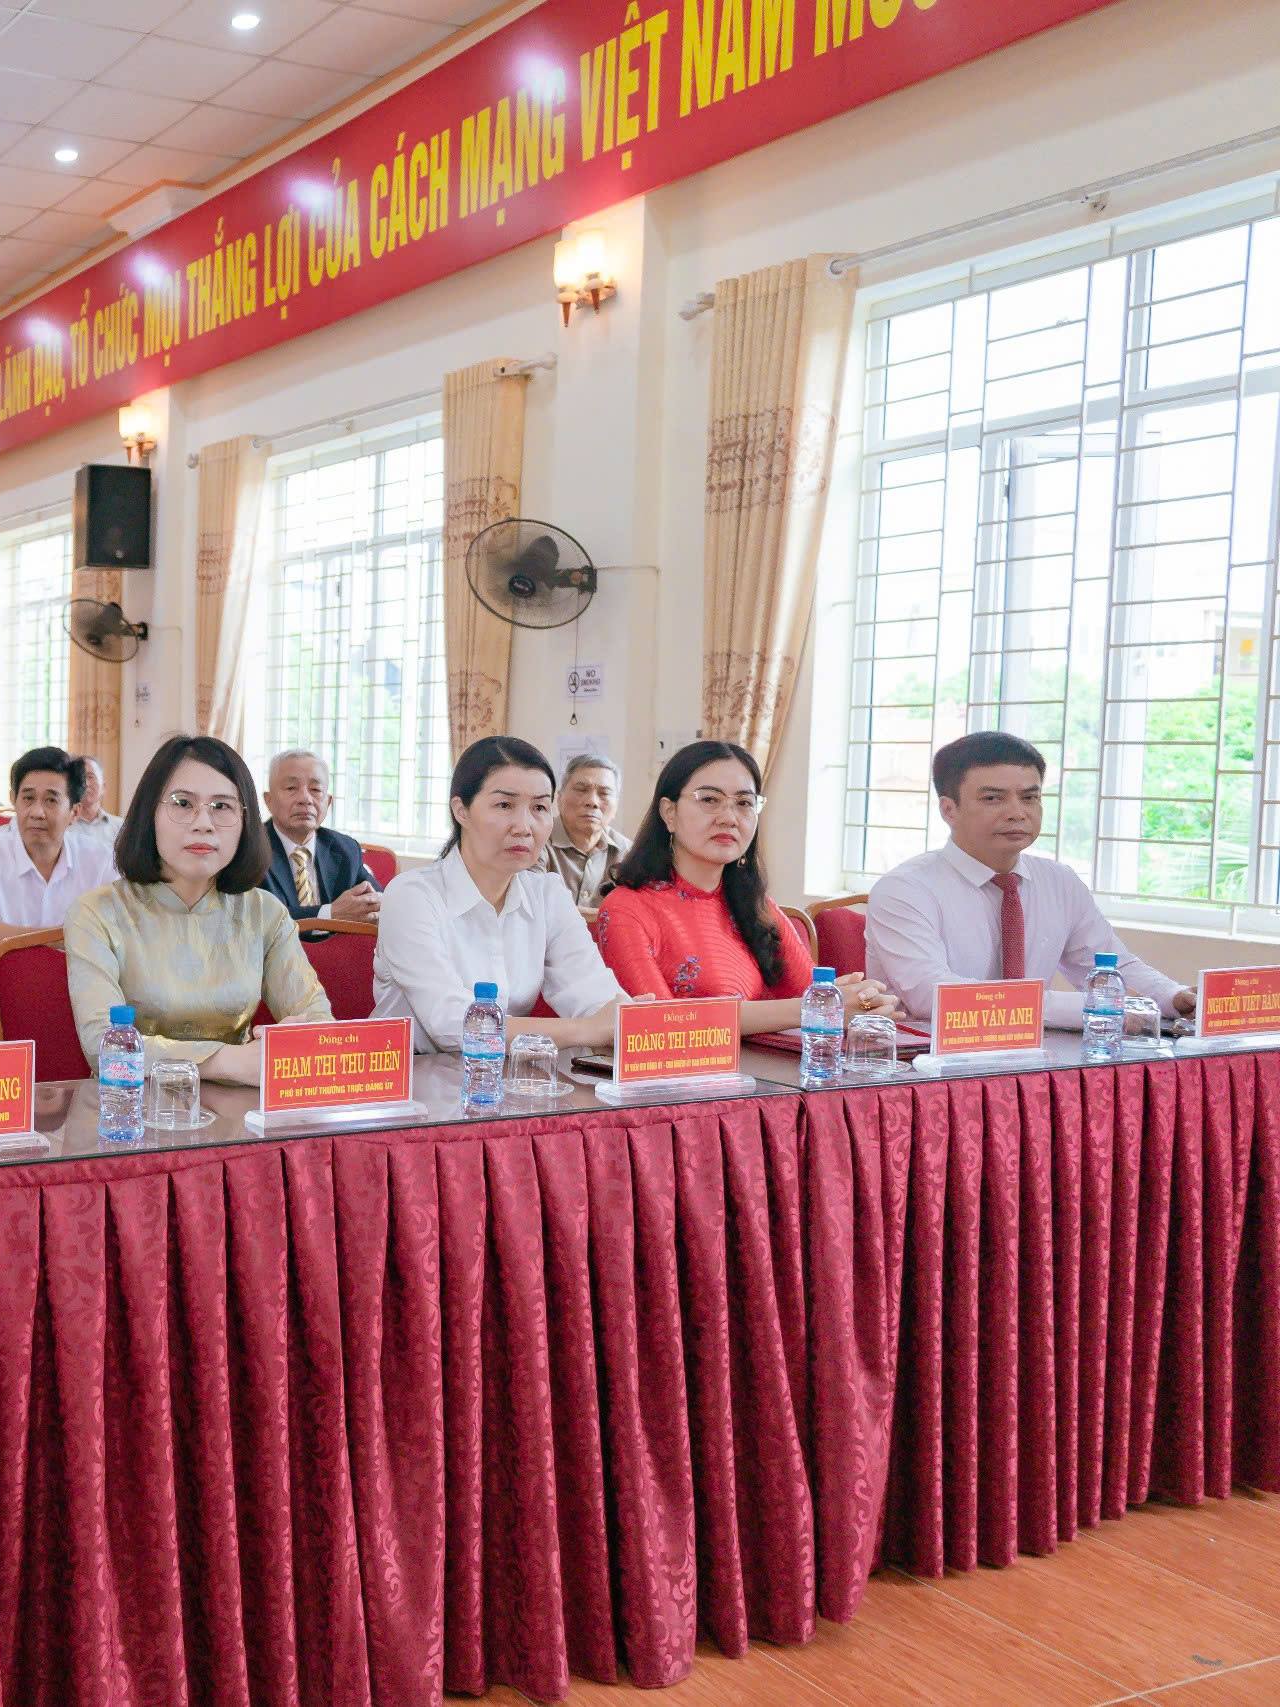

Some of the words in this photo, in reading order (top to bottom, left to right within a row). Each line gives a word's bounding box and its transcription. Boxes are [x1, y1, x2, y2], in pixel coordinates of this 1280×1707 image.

[70, 288, 89, 389] TỔ
[93, 282, 139, 380] CHỨC
[144, 269, 180, 367] MỌI
[187, 217, 257, 339] THẮNG
[263, 203, 300, 320] LỢI
[308, 157, 360, 287] CỦA
[370, 131, 450, 259] CÁCH
[459, 67, 566, 226] MẠNG
[579, 1, 669, 171] VIỆT
[679, 0, 795, 118] NAM
[945, 1011, 979, 1033] PHẠM
[1009, 1007, 1034, 1026] ANH
[626, 1029, 665, 1053] HOÀNG
[668, 1032, 686, 1054] THỊ
[689, 1027, 731, 1047] PHƯƠNG
[273, 1057, 311, 1083] PHẠM
[315, 1054, 336, 1081] THỊ
[341, 1052, 366, 1074] THU
